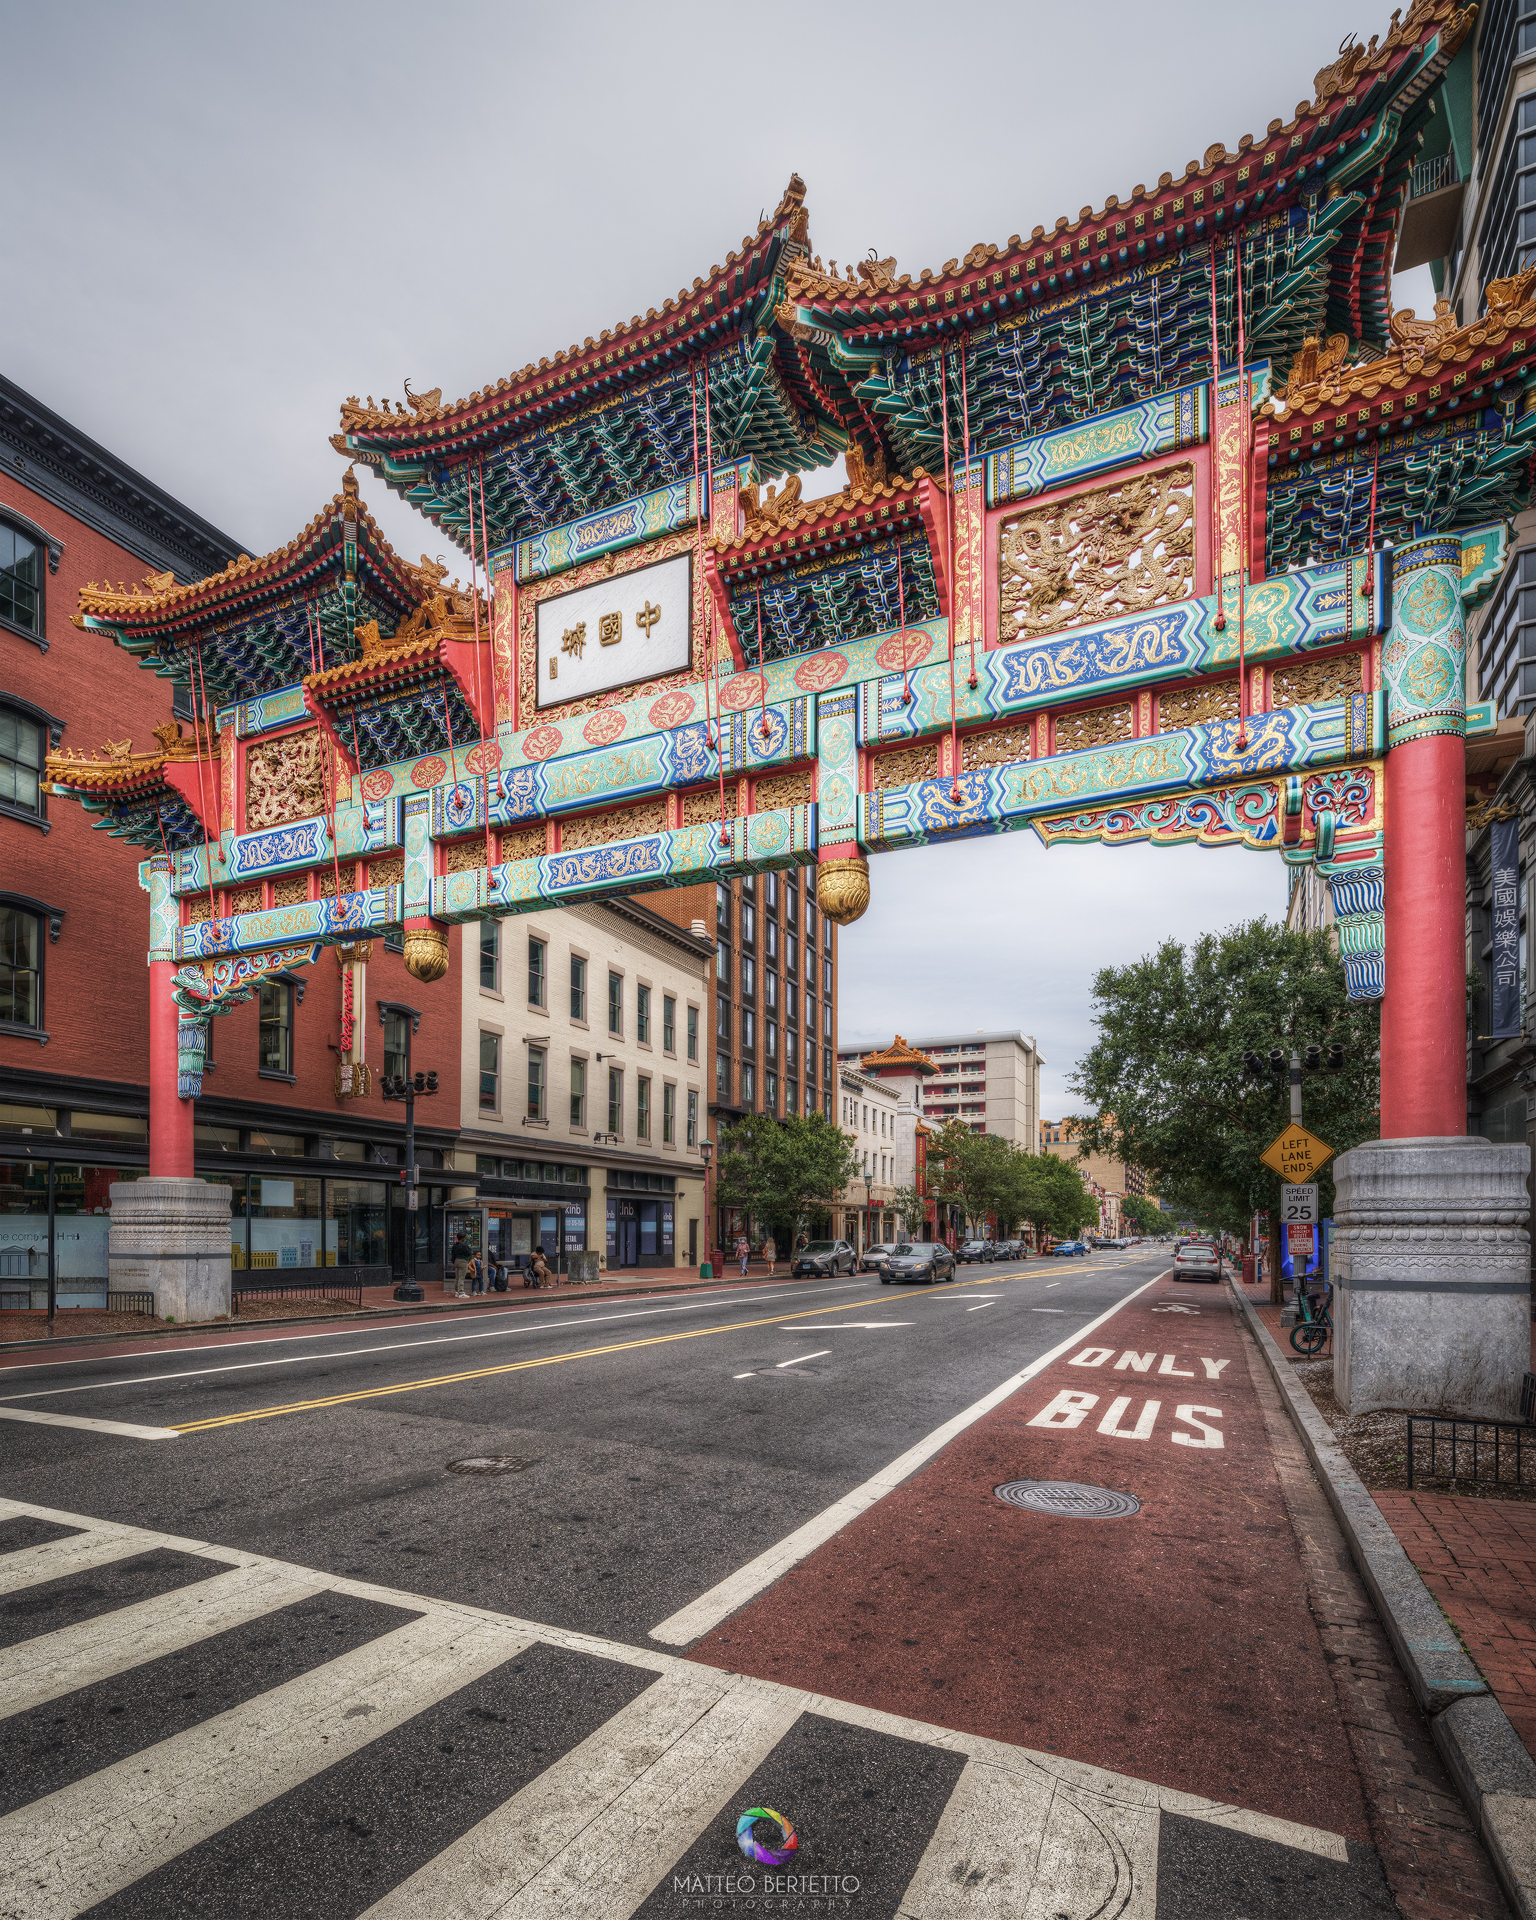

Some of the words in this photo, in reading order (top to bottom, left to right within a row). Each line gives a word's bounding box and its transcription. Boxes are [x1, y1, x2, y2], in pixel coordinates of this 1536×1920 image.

[561, 600, 662, 660] 中國城
[1494, 868, 1517, 987] 美國娛樂公司
[340, 969, 355, 1052] Walgreens
[1281, 1150, 1312, 1162] LANE
[1282, 1138, 1309, 1150] LEFT
[1283, 1162, 1314, 1174] ENDS
[1287, 1206, 1312, 1220] 25
[1067, 1347, 1231, 1380] ONLY
[1025, 1389, 1225, 1449] BUS
